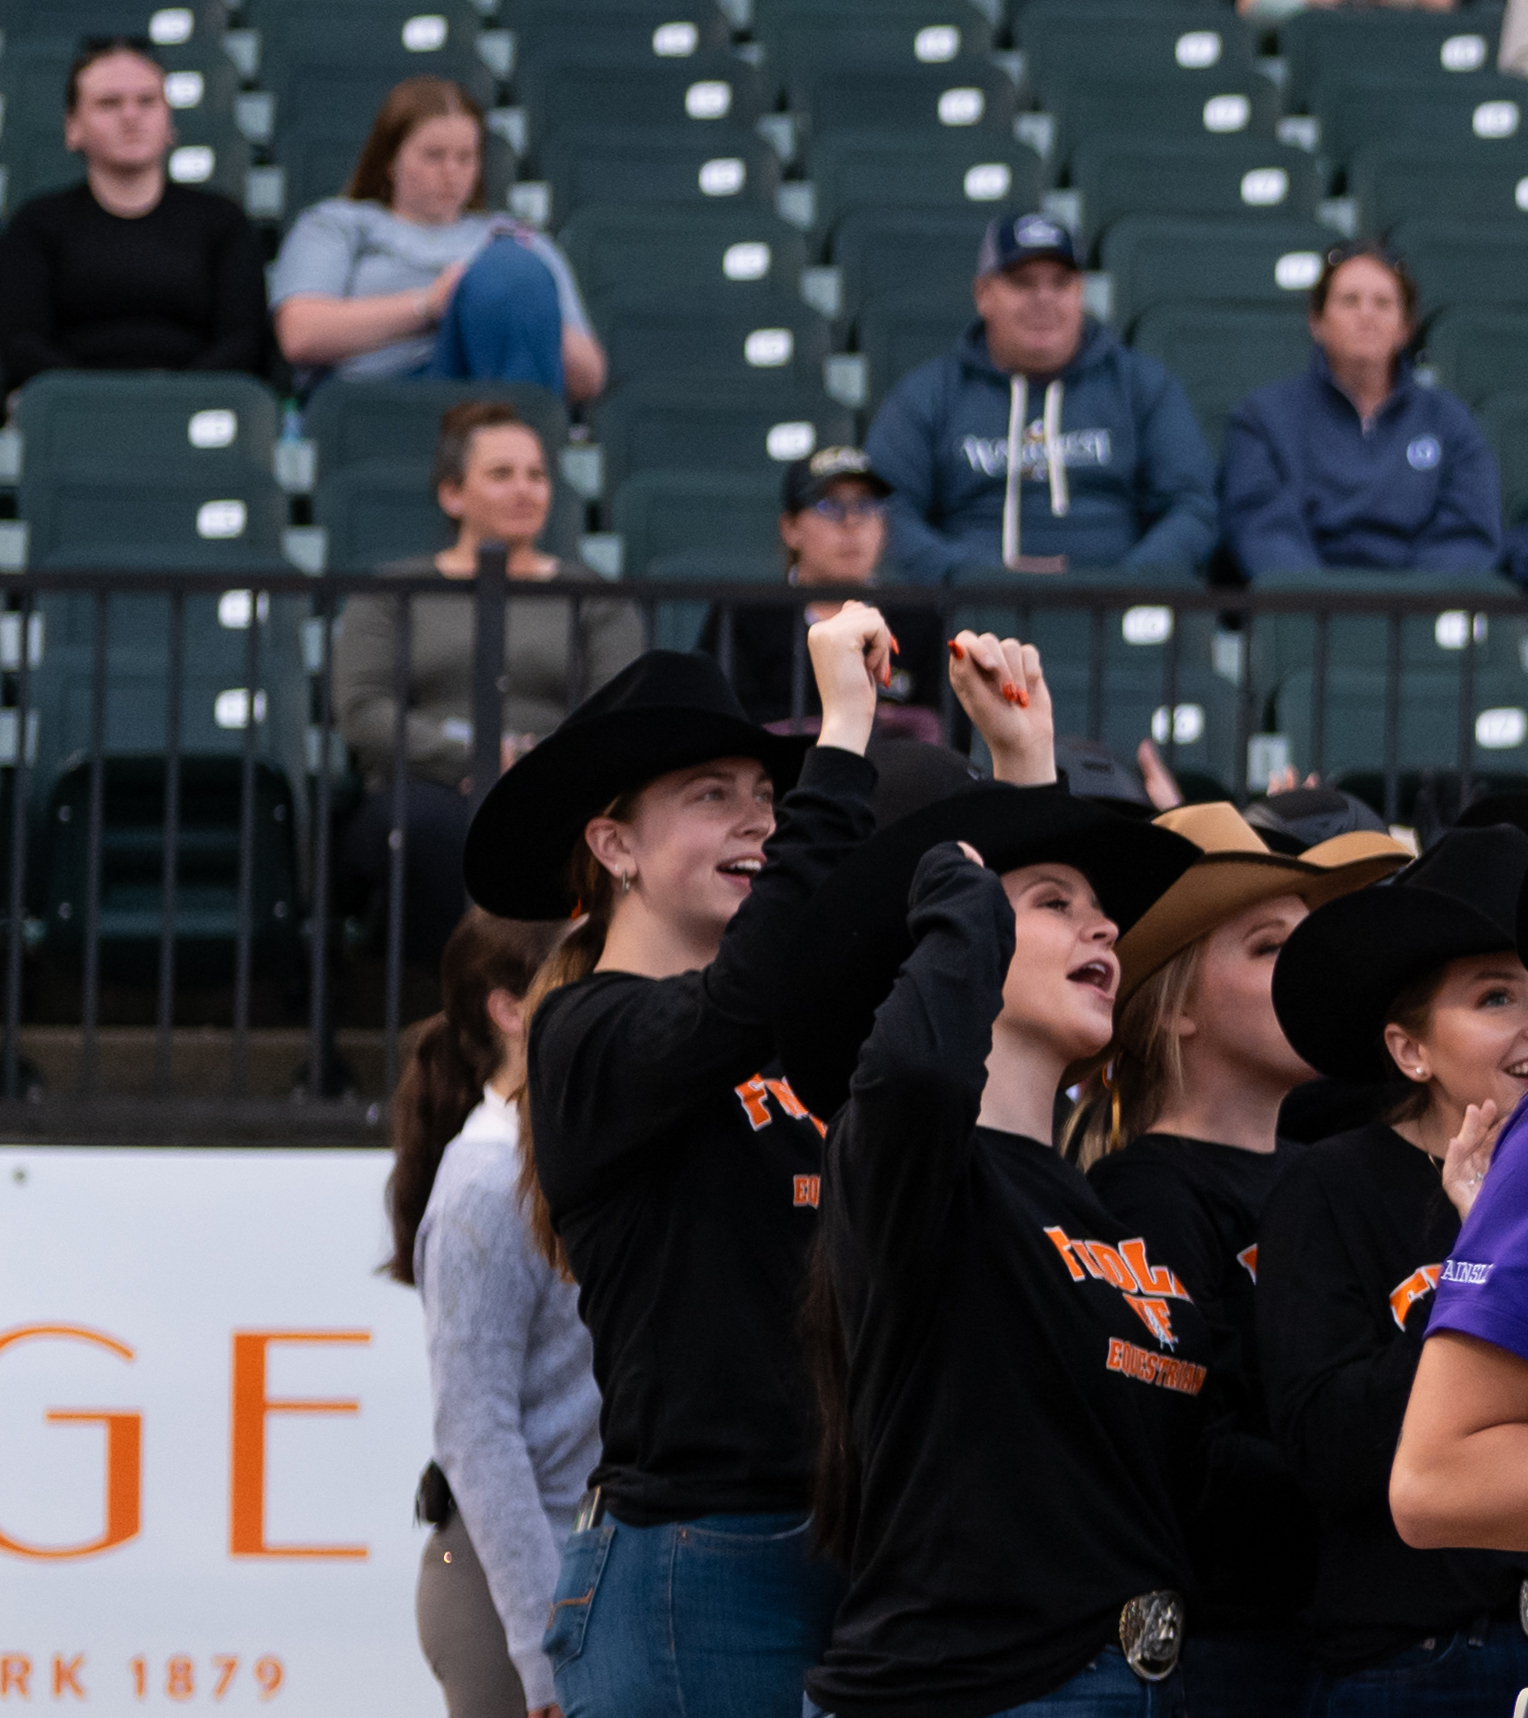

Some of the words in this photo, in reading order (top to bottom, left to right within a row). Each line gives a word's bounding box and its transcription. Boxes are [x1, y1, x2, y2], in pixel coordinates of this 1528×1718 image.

[1106, 1336, 1207, 1396] EQUESTRIAN
[0, 1324, 373, 1562] GE
[0, 1653, 88, 1699] RK
[130, 1655, 286, 1700] 1879
